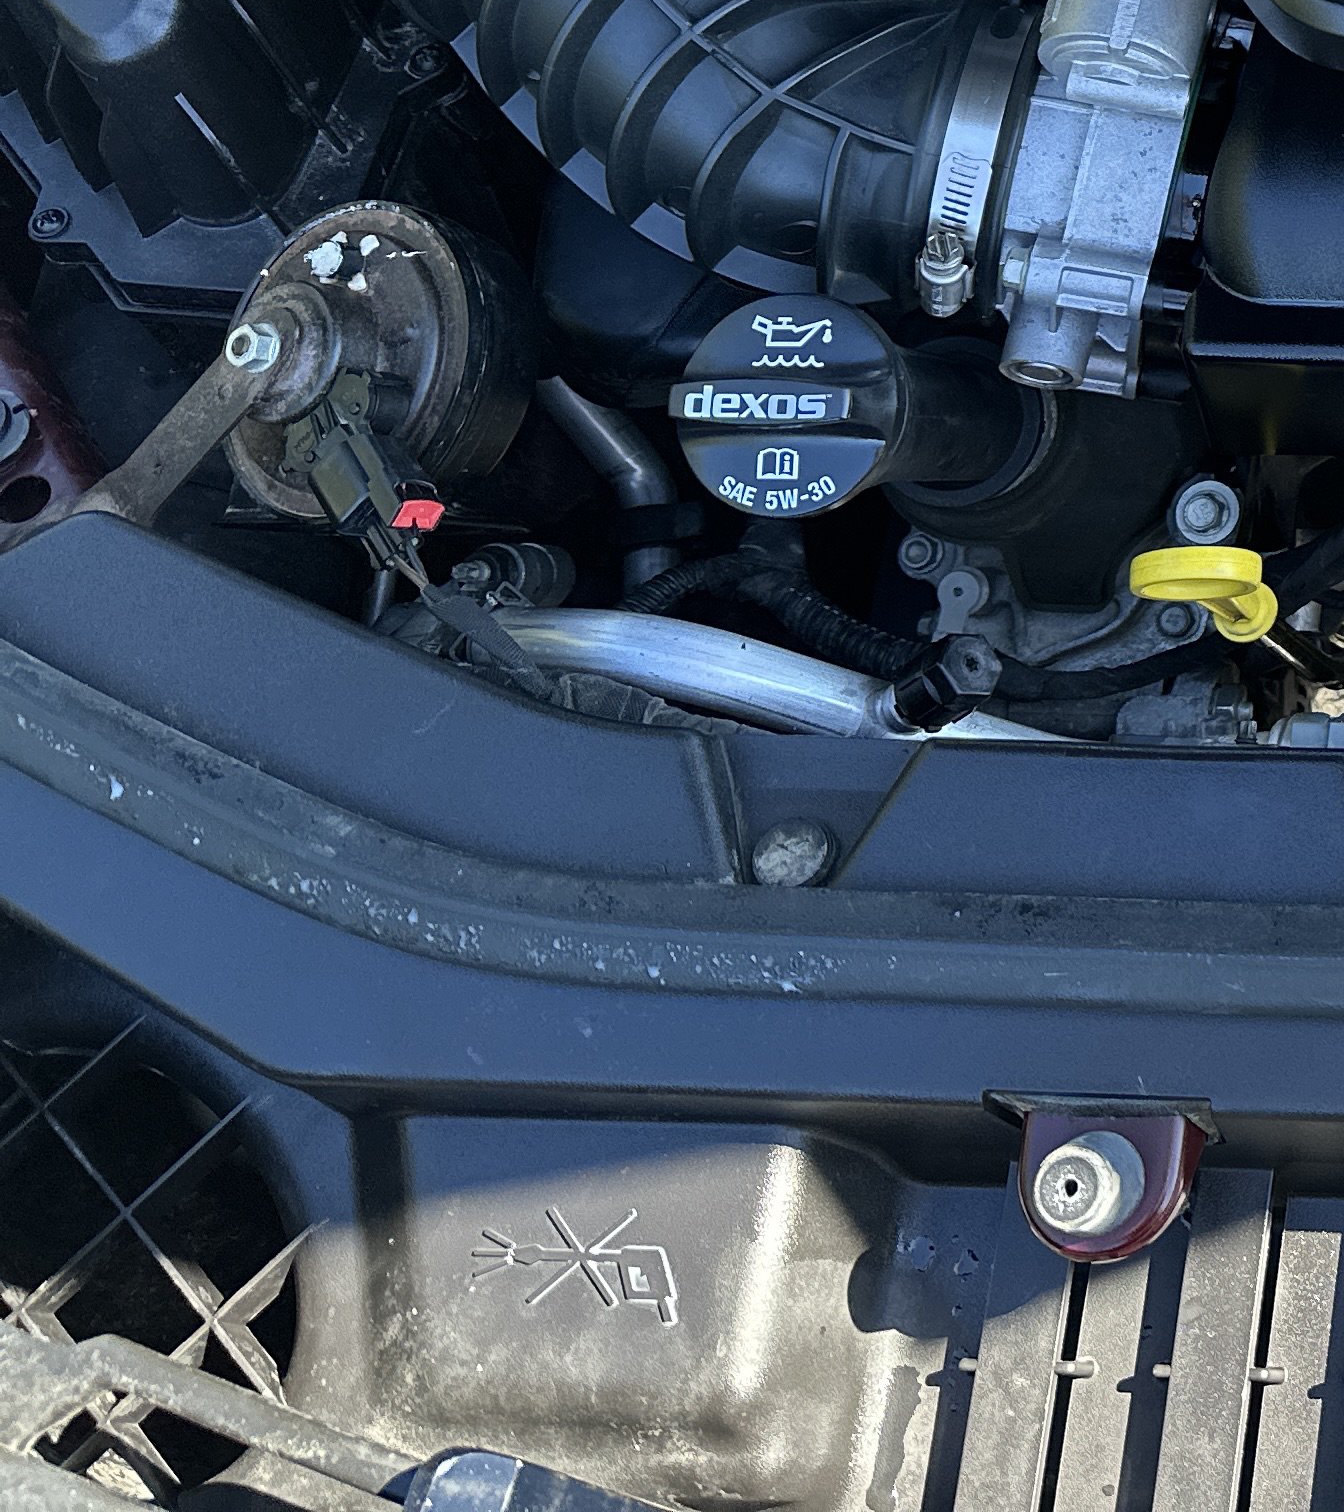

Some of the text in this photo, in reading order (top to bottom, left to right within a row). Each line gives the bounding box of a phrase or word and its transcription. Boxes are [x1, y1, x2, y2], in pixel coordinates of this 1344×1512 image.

[684, 385, 827, 420] dexos
[718, 475, 836, 509] SAE 5W-30
